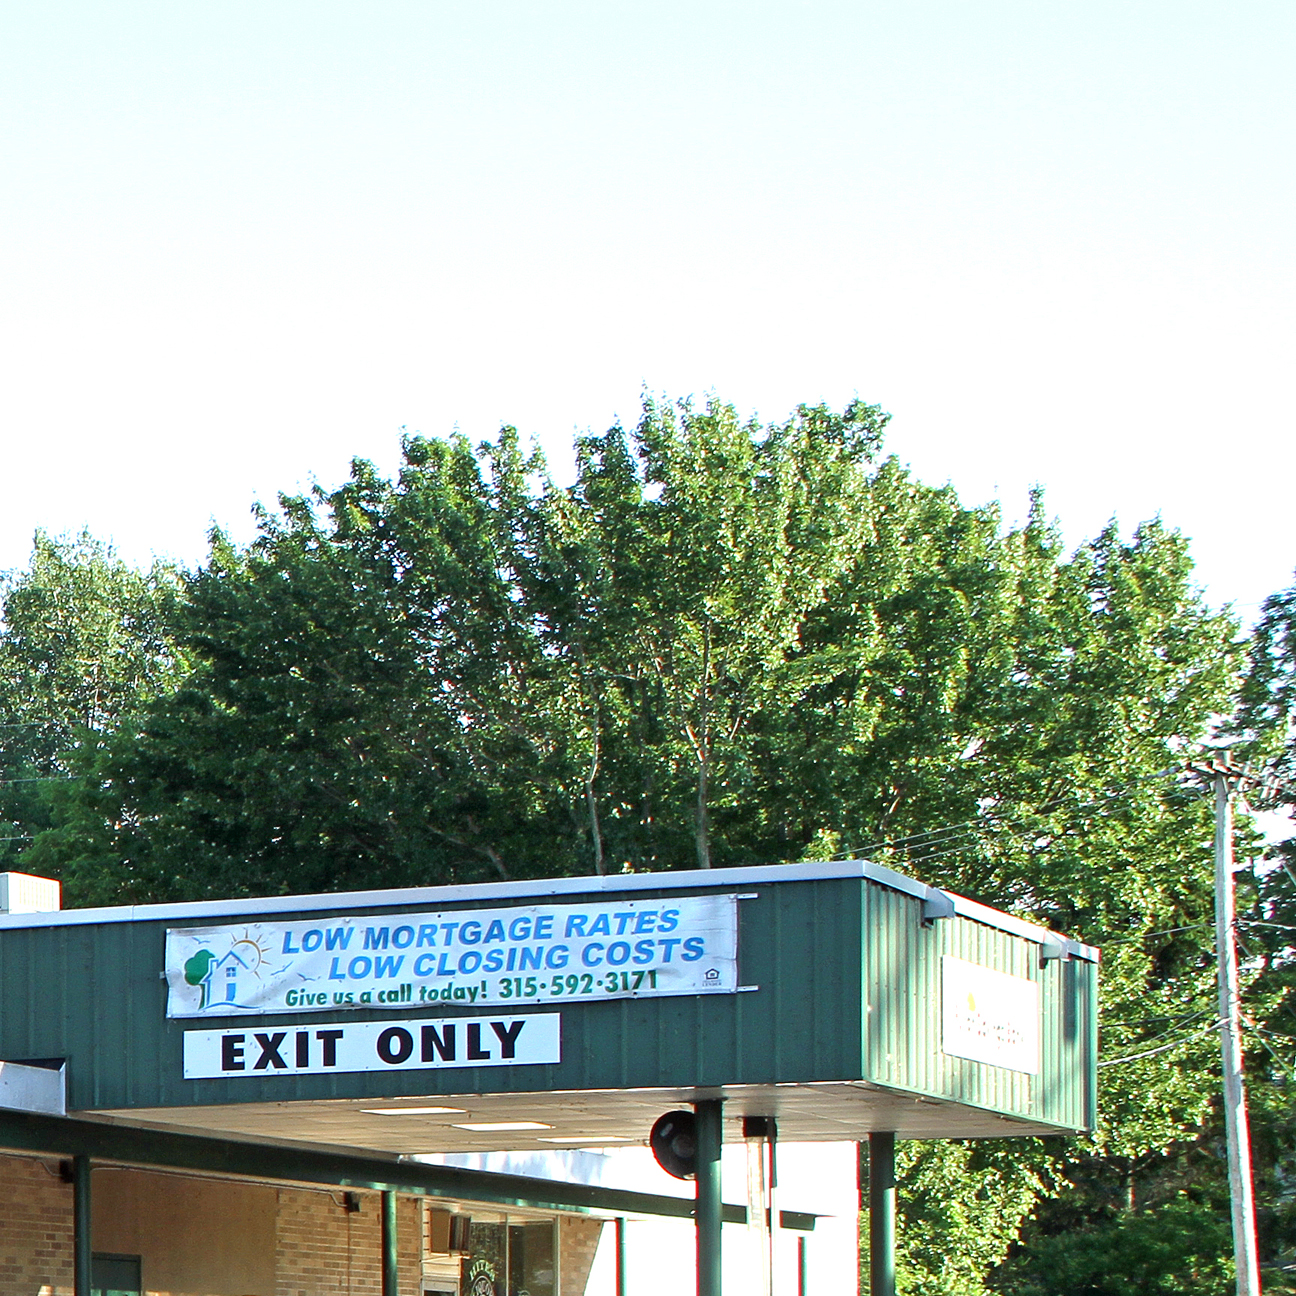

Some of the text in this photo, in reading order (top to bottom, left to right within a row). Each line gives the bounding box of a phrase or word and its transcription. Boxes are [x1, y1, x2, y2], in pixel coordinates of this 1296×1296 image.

[281, 909, 680, 954] LOW MORTGAGE RATES
[328, 937, 705, 980] LOW CLOSING COSTS
[285, 988, 327, 1006] Give
[333, 990, 354, 1005] us
[359, 991, 373, 1004] a
[377, 983, 412, 1003] call
[419, 980, 487, 1004] today!
[221, 1020, 526, 1071] EXIT ONLY
